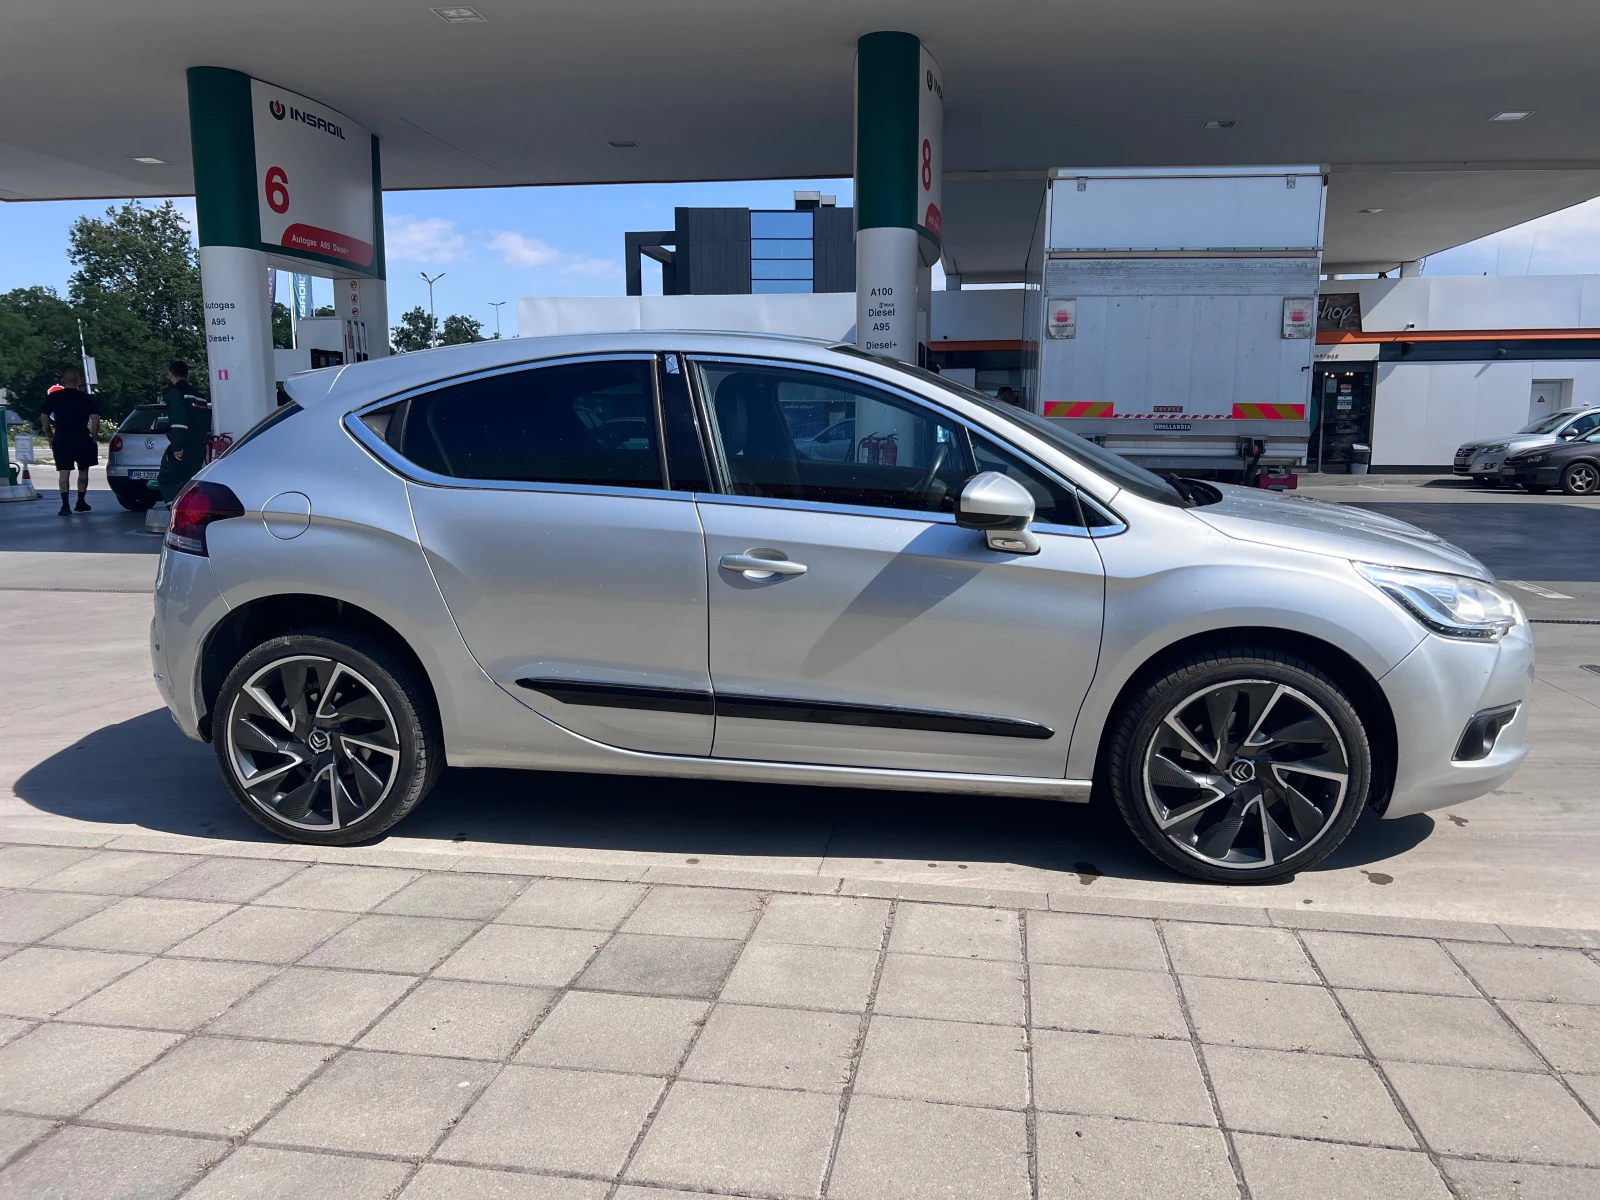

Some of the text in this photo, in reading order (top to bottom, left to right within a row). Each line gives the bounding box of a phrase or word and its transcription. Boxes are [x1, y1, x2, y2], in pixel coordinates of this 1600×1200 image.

[289, 106, 346, 140] INSAOIL
[921, 138, 932, 192] 8
[264, 166, 290, 214] 6
[291, 234, 317, 247] Autogas
[320, 240, 330, 250] A95
[870, 287, 893, 297] A100
[205, 302, 236, 311] Autogas
[868, 308, 895, 317] Diesel
[211, 317, 227, 326] A95
[872, 322, 891, 332] A95
[208, 334, 236, 343] Diesel+
[866, 340, 898, 350] Diesel+
[1154, 423, 1191, 431] DHOLLANDIA
